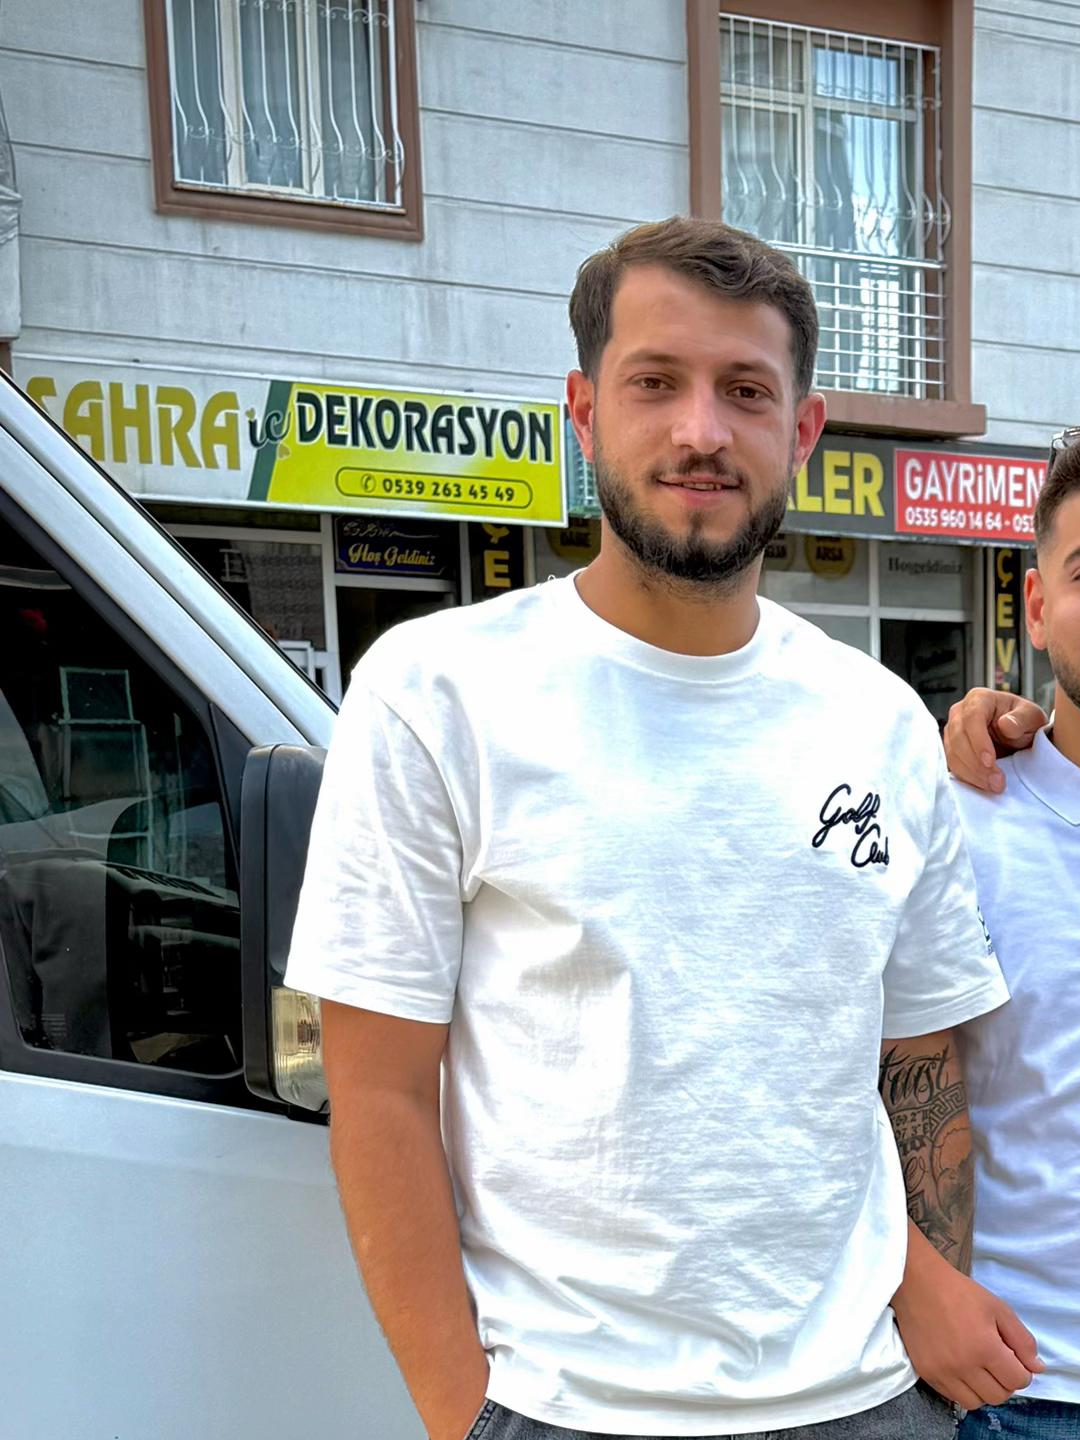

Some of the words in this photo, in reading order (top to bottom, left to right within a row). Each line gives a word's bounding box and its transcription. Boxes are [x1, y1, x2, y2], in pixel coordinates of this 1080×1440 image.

[296, 391, 552, 463] DEKORASYON
[382, 478, 425, 495] 0539
[432, 482, 461, 498] 263
[469, 485, 488, 500] 45
[495, 488, 514, 502] 49
[787, 450, 885, 517] LER
[905, 506, 938, 527] 0535
[940, 509, 966, 529] 960
[968, 511, 983, 530] 14
[383, 546, 436, 566] Geldiniz
[812, 783, 881, 848] Golf
